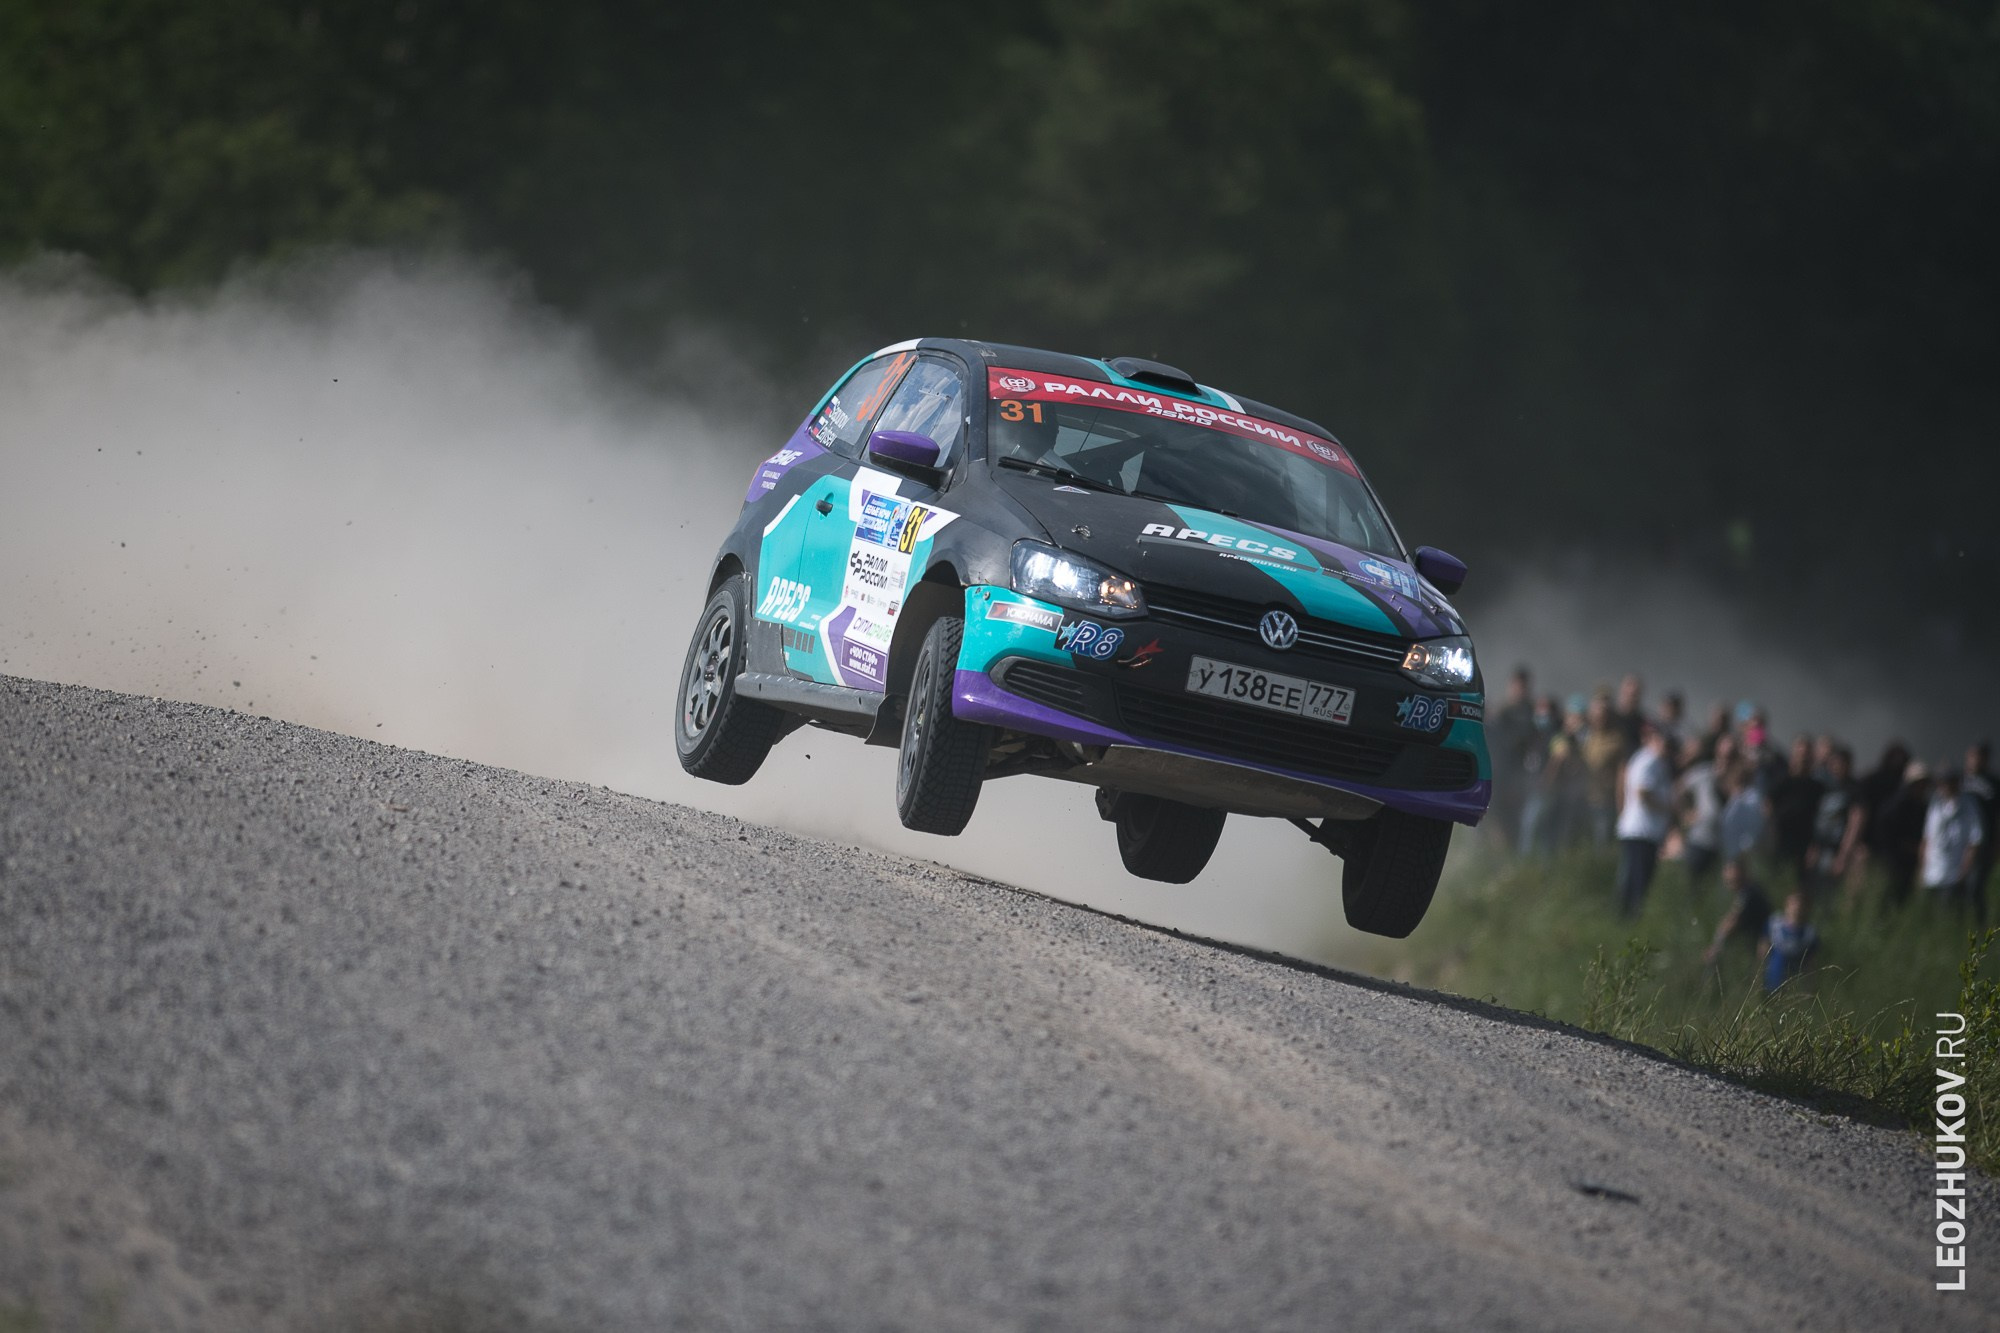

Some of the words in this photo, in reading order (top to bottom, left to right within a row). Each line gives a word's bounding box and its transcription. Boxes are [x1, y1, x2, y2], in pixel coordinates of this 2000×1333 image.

[856, 352, 918, 422] 31
[1001, 400, 1043, 424] 31
[1043, 382, 1163, 408] РАЛЛИ
[1173, 402, 1302, 447] РОССИИ
[900, 507, 927, 552] 31
[1142, 523, 1298, 561] APECS
[859, 568, 889, 590] РОССИИ
[863, 553, 889, 573] РАЛЛИ
[757, 576, 812, 623] APECS
[1006, 607, 1054, 627] YOKOHAMA
[1062, 620, 1125, 661] R8
[1308, 684, 1349, 712] 777
[1312, 706, 1334, 719] RUS
[1401, 695, 1447, 733] R8
